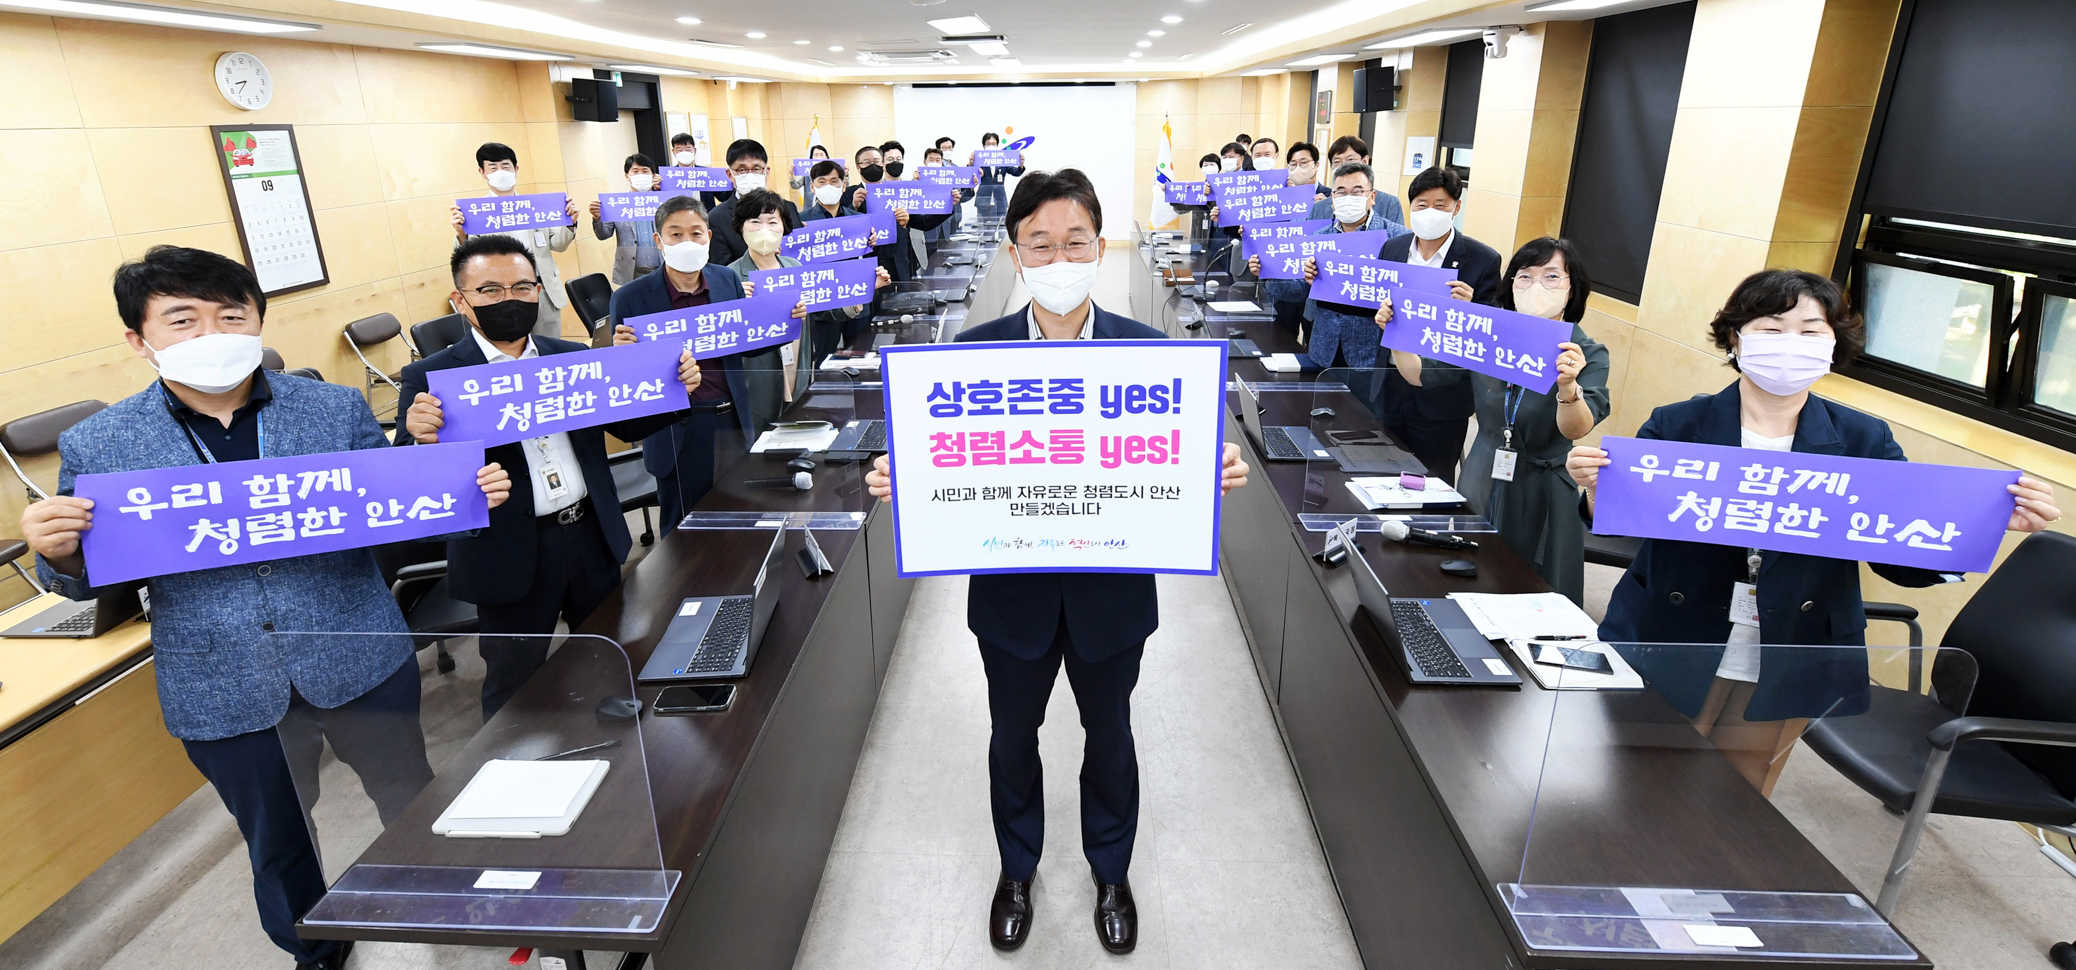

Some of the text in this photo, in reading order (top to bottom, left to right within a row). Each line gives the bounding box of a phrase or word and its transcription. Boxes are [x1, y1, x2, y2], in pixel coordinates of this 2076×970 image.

[666, 170, 710, 178] 우리 함께,
[676, 178, 706, 189] 청렴한
[1214, 175, 1264, 186] 우리 함께,
[261, 179, 274, 192] 09
[874, 188, 925, 200] 우리 함께,
[468, 200, 536, 216] 우리 함께,
[608, 196, 662, 207] 우리 함께,
[885, 199, 945, 212] 청렴한 안산
[1224, 194, 1283, 210] 우리 함께,
[1237, 201, 1307, 221] 청렴한 안산
[486, 211, 561, 231] 청렴한 안산
[784, 228, 845, 250] 우리 함께,
[1250, 228, 1271, 240] 우리
[796, 236, 868, 263] 청렴한 안산
[1266, 240, 1341, 257] 우리 함께,
[763, 269, 840, 292] 우리 함께,
[1325, 261, 1353, 276] 우리
[1360, 266, 1403, 288] 함께,
[799, 281, 867, 305] 렴한 안산
[1341, 279, 1391, 304] 청렴한
[643, 309, 750, 342] 우리 함께,
[746, 321, 788, 342] 안산
[1401, 299, 1497, 344] 우리 함께,
[1418, 323, 1546, 377] 청렴한 안산
[459, 361, 612, 407] 우리 함께,
[495, 377, 664, 431] 청렴한 안산
[927, 378, 1182, 419] 상호존중 yes!
[930, 429, 1180, 469] 청렴소통 yes!
[1630, 455, 1859, 506] 우리 함께,
[119, 468, 368, 522] 우리 함께,
[932, 485, 1181, 502] 시민과 함께 자유로운 청렴도시 안산
[1010, 502, 1101, 516] 만들겠습니다
[183, 491, 456, 555] 청렴한 안산
[1668, 490, 1961, 551] 청렴한 안산
[982, 537, 1011, 553] 시민과
[1104, 538, 1130, 550] 안산
